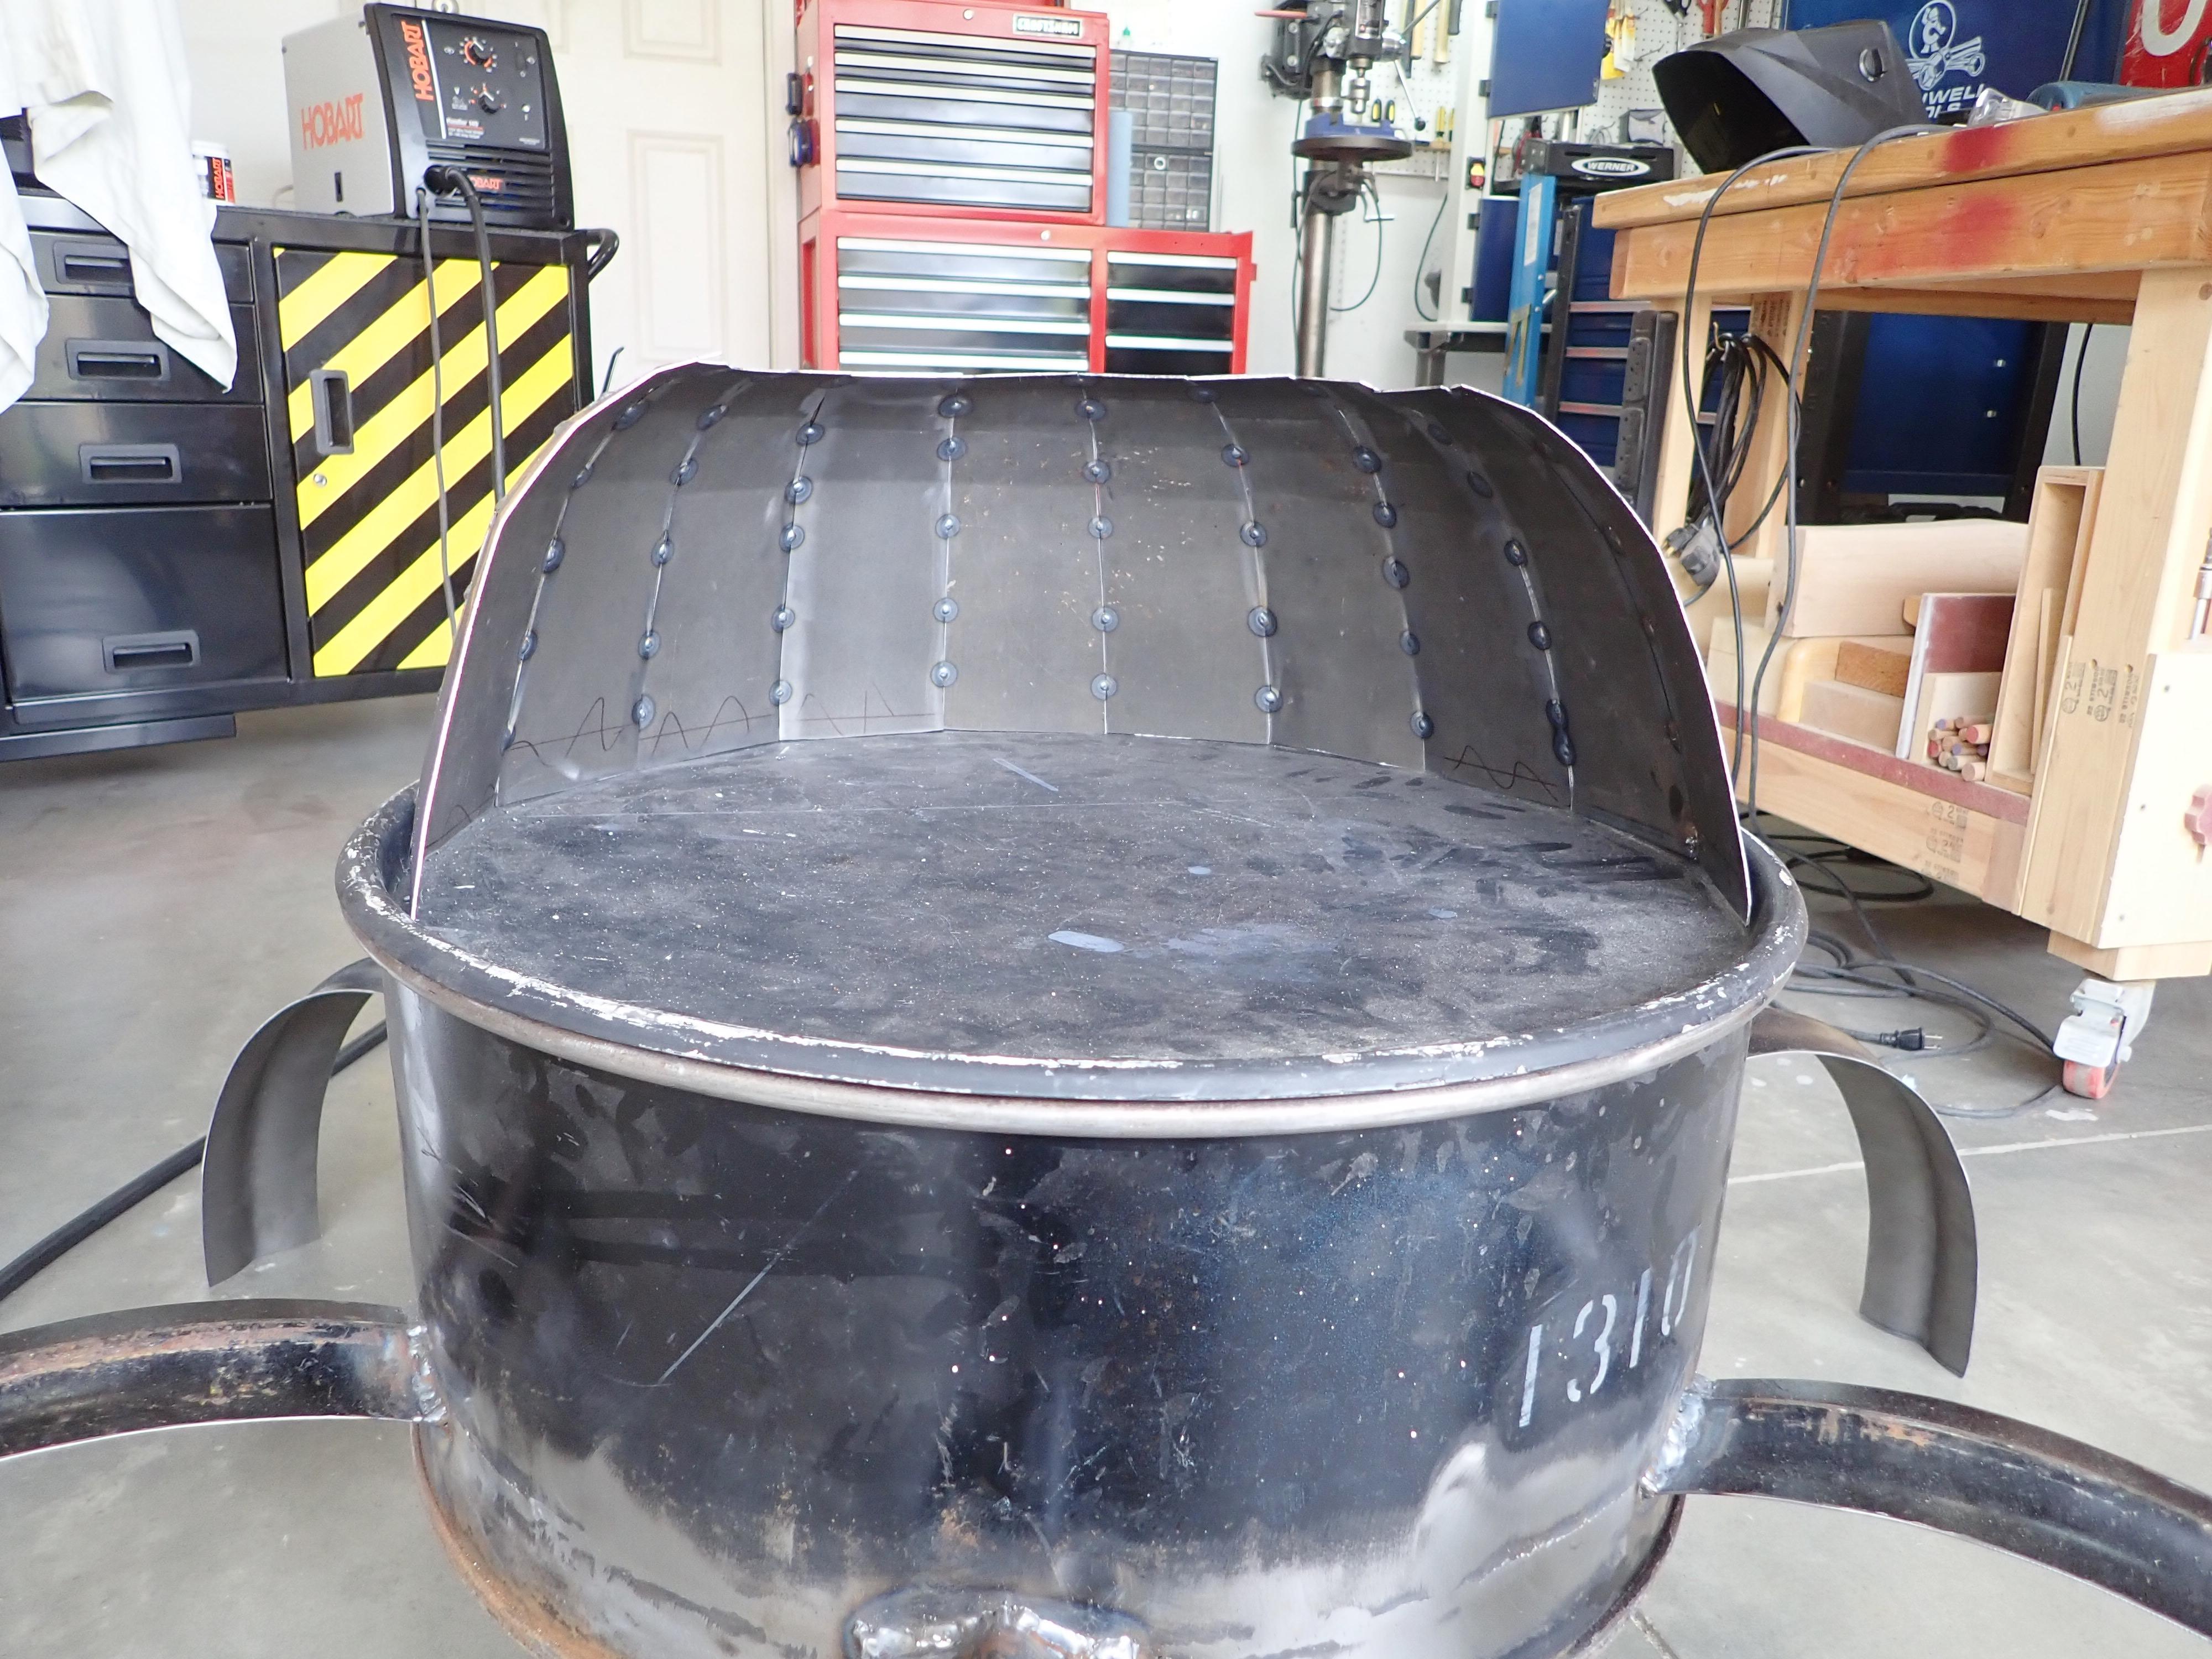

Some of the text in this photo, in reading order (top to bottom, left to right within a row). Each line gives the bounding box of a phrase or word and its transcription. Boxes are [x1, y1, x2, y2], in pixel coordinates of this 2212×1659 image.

[401, 20, 434, 101] HOBART
[301, 93, 363, 150] HOBART
[212, 157, 225, 199] HOBART
[1588, 161, 1635, 172] WERNER
[1519, 1224, 1699, 1427] 1310
